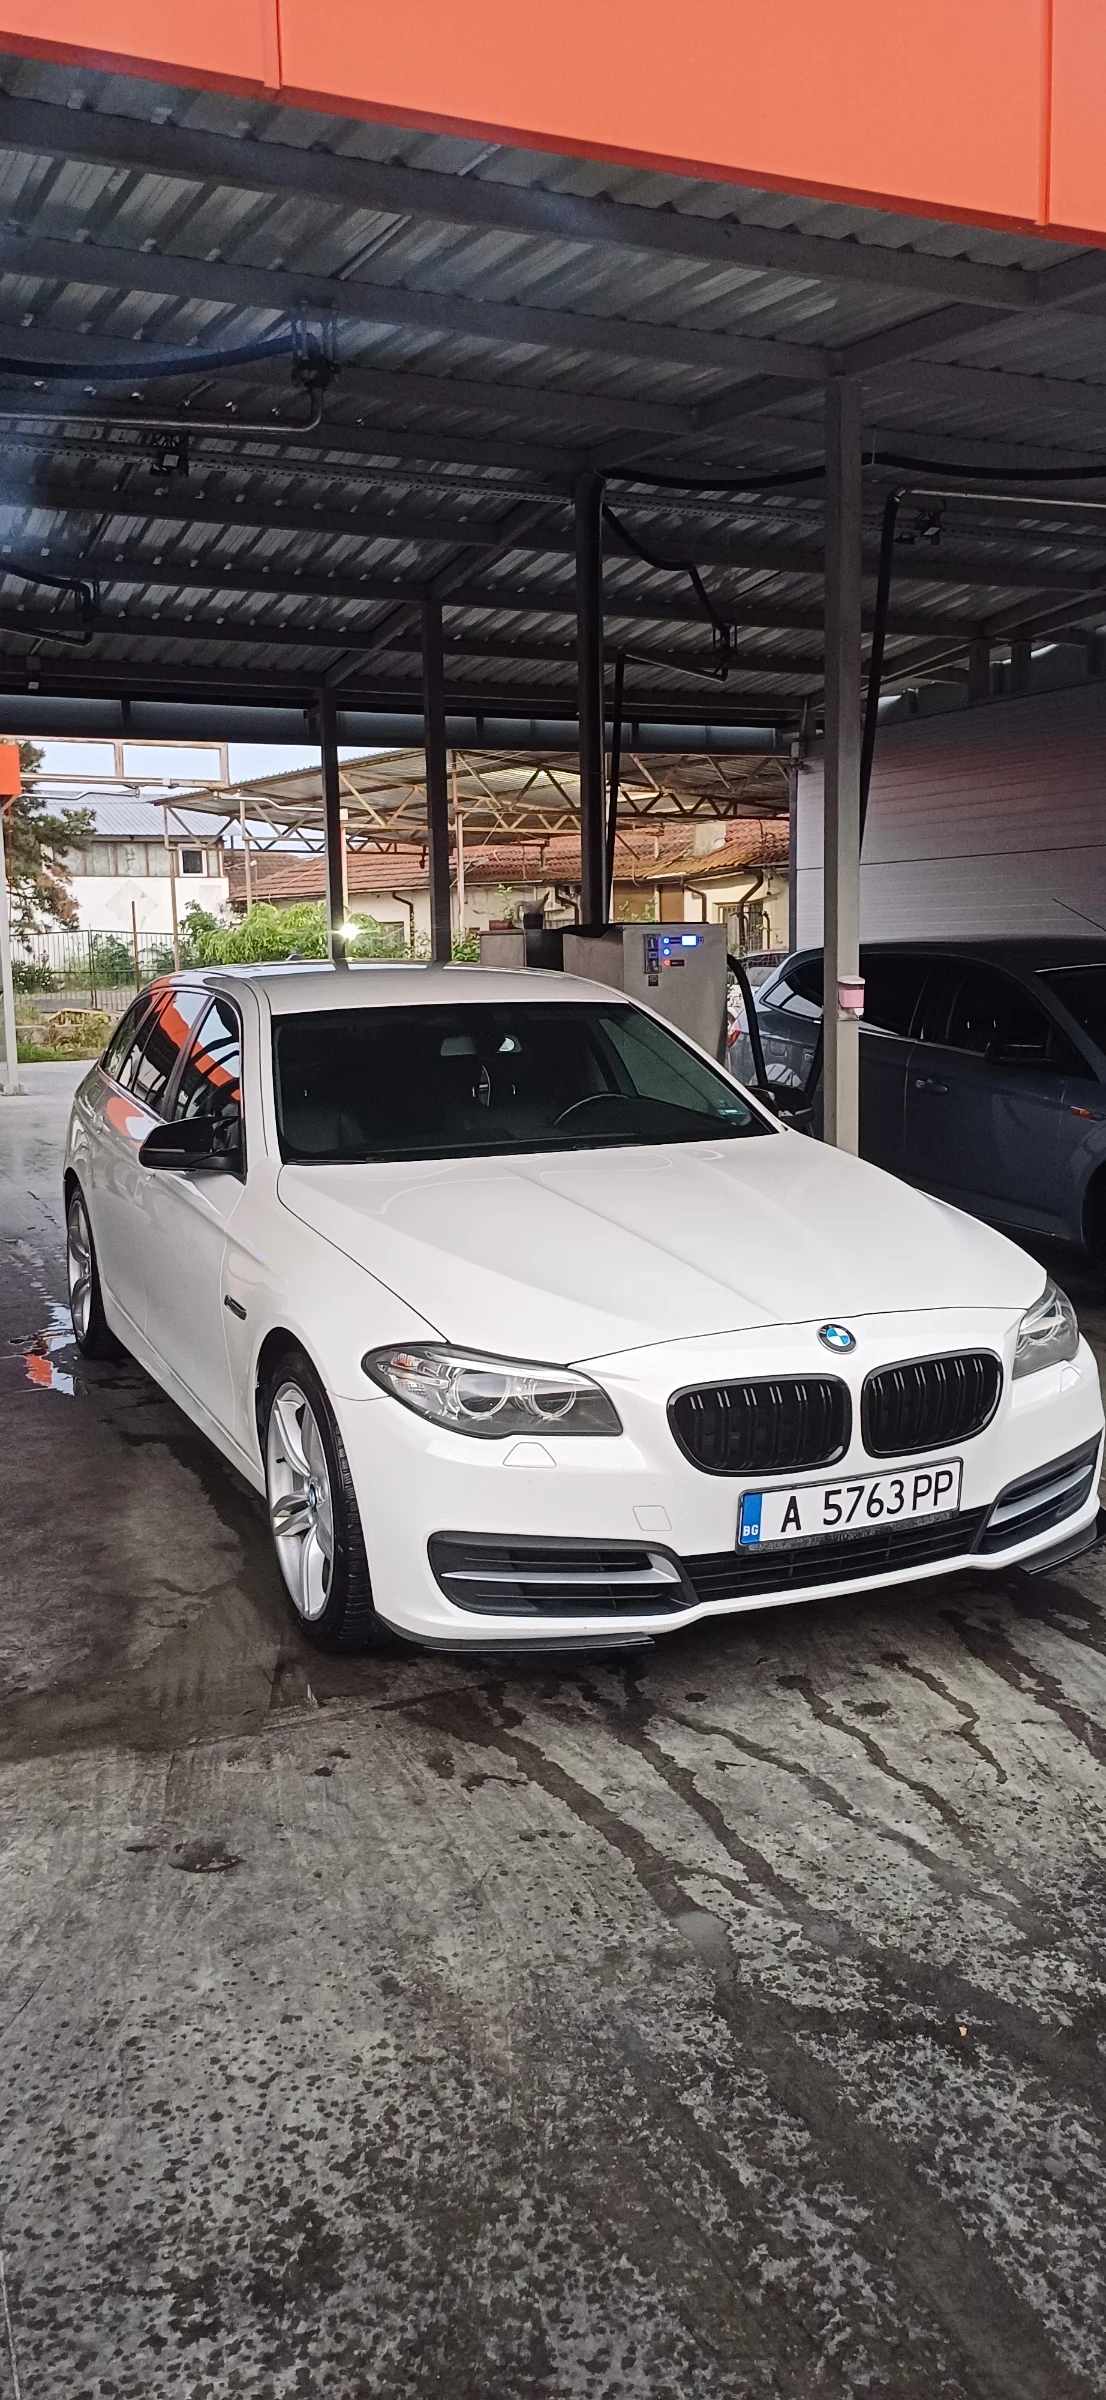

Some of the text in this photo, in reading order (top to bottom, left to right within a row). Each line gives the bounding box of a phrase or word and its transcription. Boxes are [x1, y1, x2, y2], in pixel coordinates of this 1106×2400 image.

[780, 1495, 802, 1533] A
[822, 1479, 905, 1526] 5763
[911, 1469, 954, 1512] PP
[742, 1524, 760, 1538] BG
